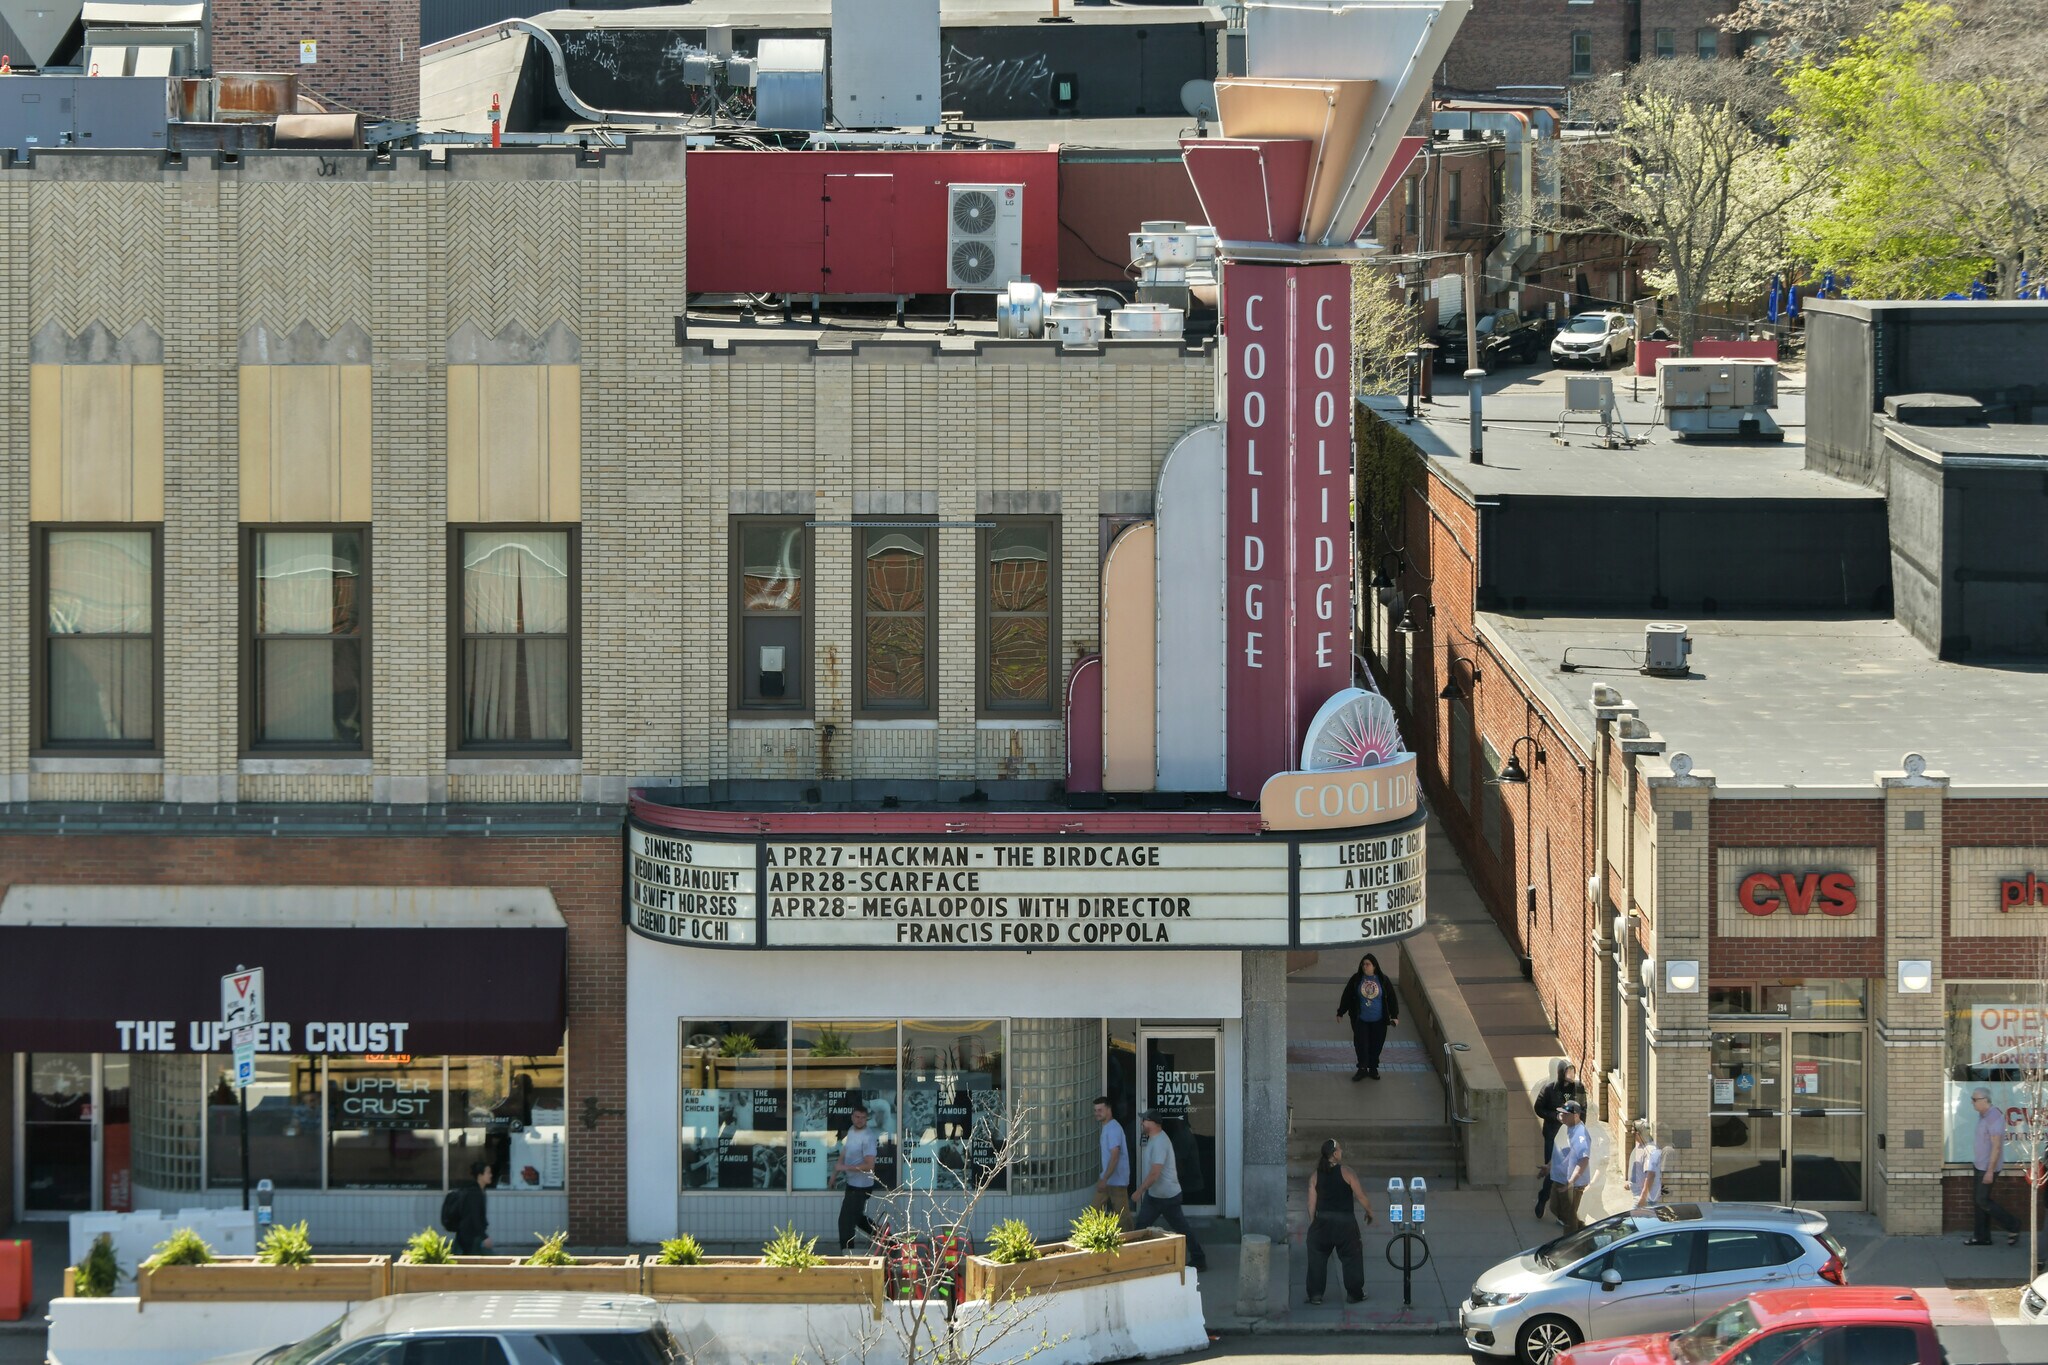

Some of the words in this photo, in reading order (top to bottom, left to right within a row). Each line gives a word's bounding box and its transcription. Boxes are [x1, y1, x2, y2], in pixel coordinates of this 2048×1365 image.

[1244, 294, 1266, 669] COOLIDGE
[1315, 294, 1335, 669] COOLIDGE
[644, 836, 693, 864] SINNERS
[993, 846, 1034, 867] THE
[1043, 846, 1160, 867] BIRDCAGE
[1339, 841, 1387, 865] LEGEND
[1391, 837, 1404, 858] OF
[634, 855, 671, 886] WEDDING
[674, 868, 740, 892] BANQUET
[1345, 869, 1355, 890] A
[1359, 864, 1390, 888] NICE
[1393, 855, 1420, 883] INDIAN
[642, 884, 675, 911] SWIFT
[679, 892, 737, 917] HORSES
[1355, 891, 1379, 914] THE
[1738, 872, 1857, 916] CVS
[1018, 897, 1069, 918] WITH
[1078, 897, 1191, 918] DIRECTOR
[637, 906, 666, 935] LEGEND
[669, 916, 686, 937] OF
[691, 918, 729, 941] OCHI
[896, 923, 993, 943] FRANCIS
[1001, 923, 1060, 943] FORD
[1068, 922, 1169, 943] COPPOLA
[1361, 909, 1413, 938] SINNERS
[116, 1021, 176, 1051] THE
[190, 1021, 291, 1052] UPER
[305, 1022, 410, 1053] CRUST
[343, 1077, 431, 1094] UPPER
[1156, 1071, 1187, 1082] SORT
[1190, 1072, 1200, 1080] OF
[754, 1089, 769, 1097] THE
[829, 1091, 847, 1099] SORT
[1156, 1082, 1205, 1094] FAMOUS
[343, 1097, 431, 1115] CRUST
[754, 1097, 778, 1105] UPPER
[754, 1105, 778, 1113] CRUST
[1156, 1094, 1192, 1106] PIZZA
[938, 1107, 967, 1115] FAMOUS
[720, 1146, 729, 1154] OF
[793, 1140, 807, 1148] THE
[793, 1148, 816, 1156] UPPER
[719, 1154, 749, 1162] FAMOUS
[793, 1156, 816, 1164] CRUST
